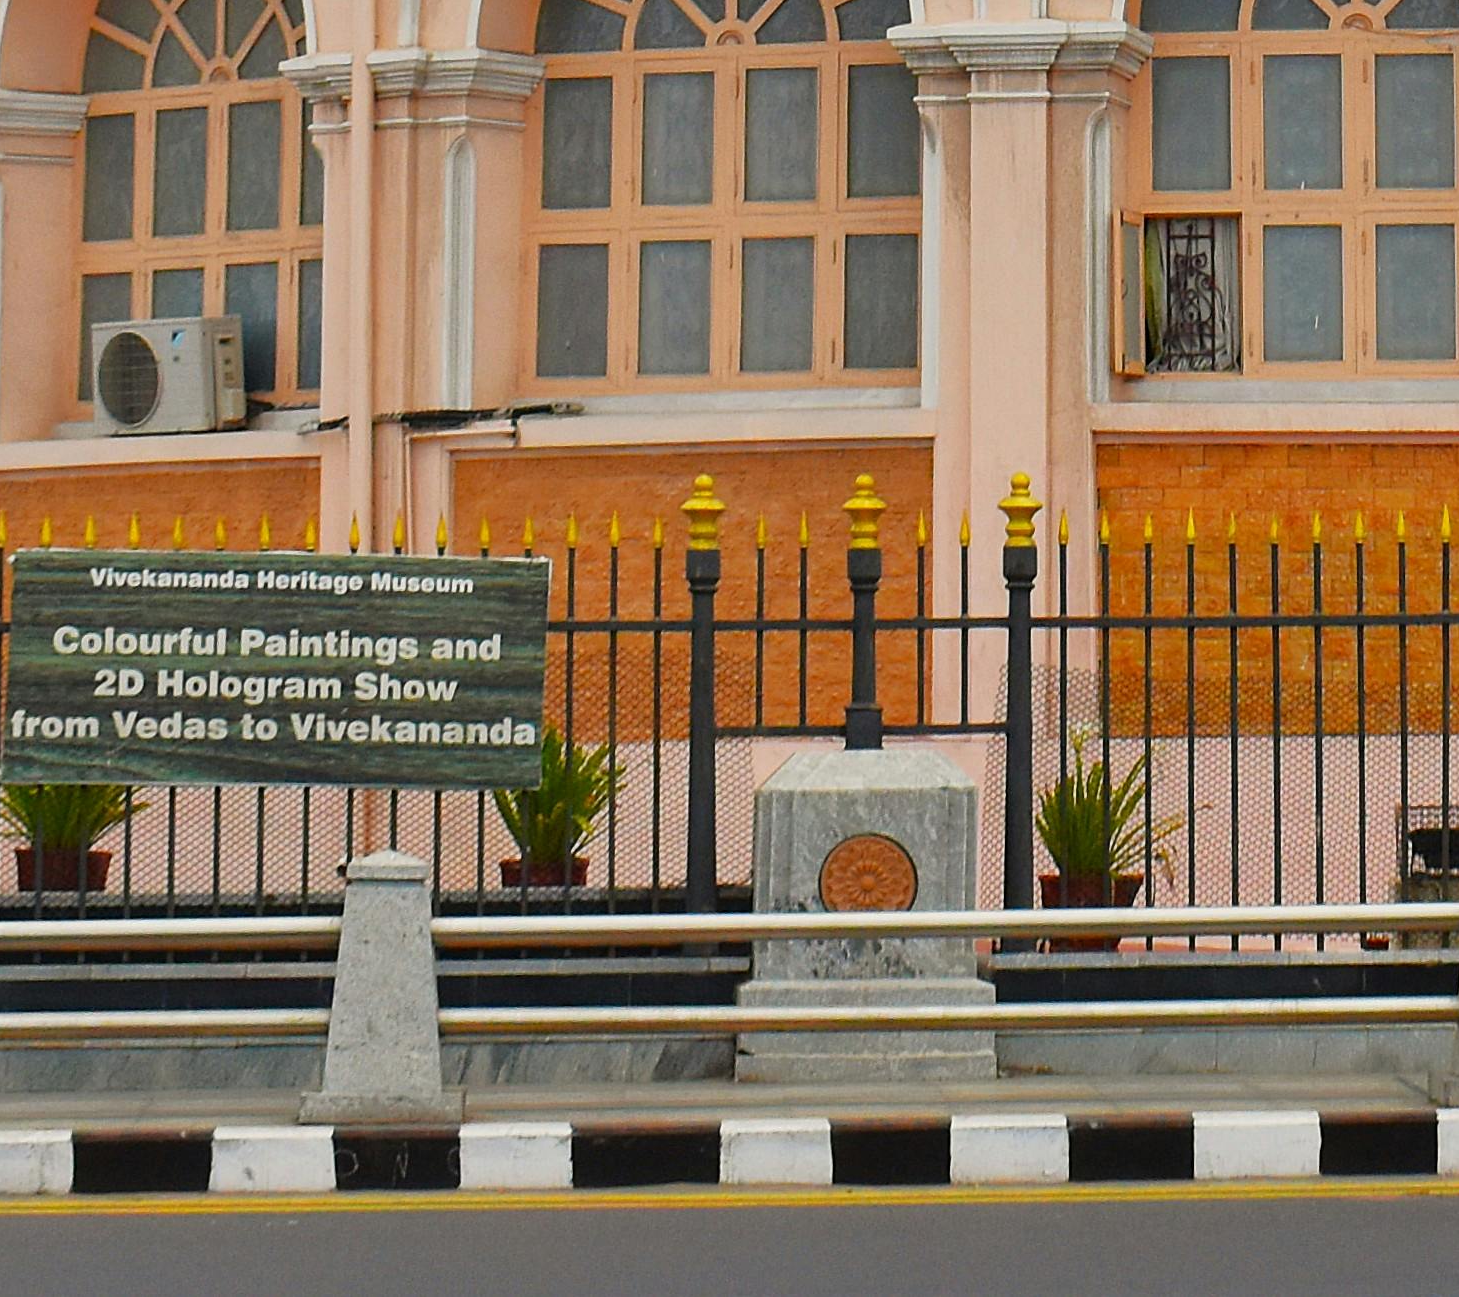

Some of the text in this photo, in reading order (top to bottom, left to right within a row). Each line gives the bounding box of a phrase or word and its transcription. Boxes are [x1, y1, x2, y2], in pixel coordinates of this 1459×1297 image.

[90, 567, 474, 595] Vivekananda Heritage Museum
[53, 625, 502, 666] Colourful Paintings and
[93, 668, 458, 705] 2D Hologram Show
[11, 709, 536, 745] from Vedas to Vivekananda
